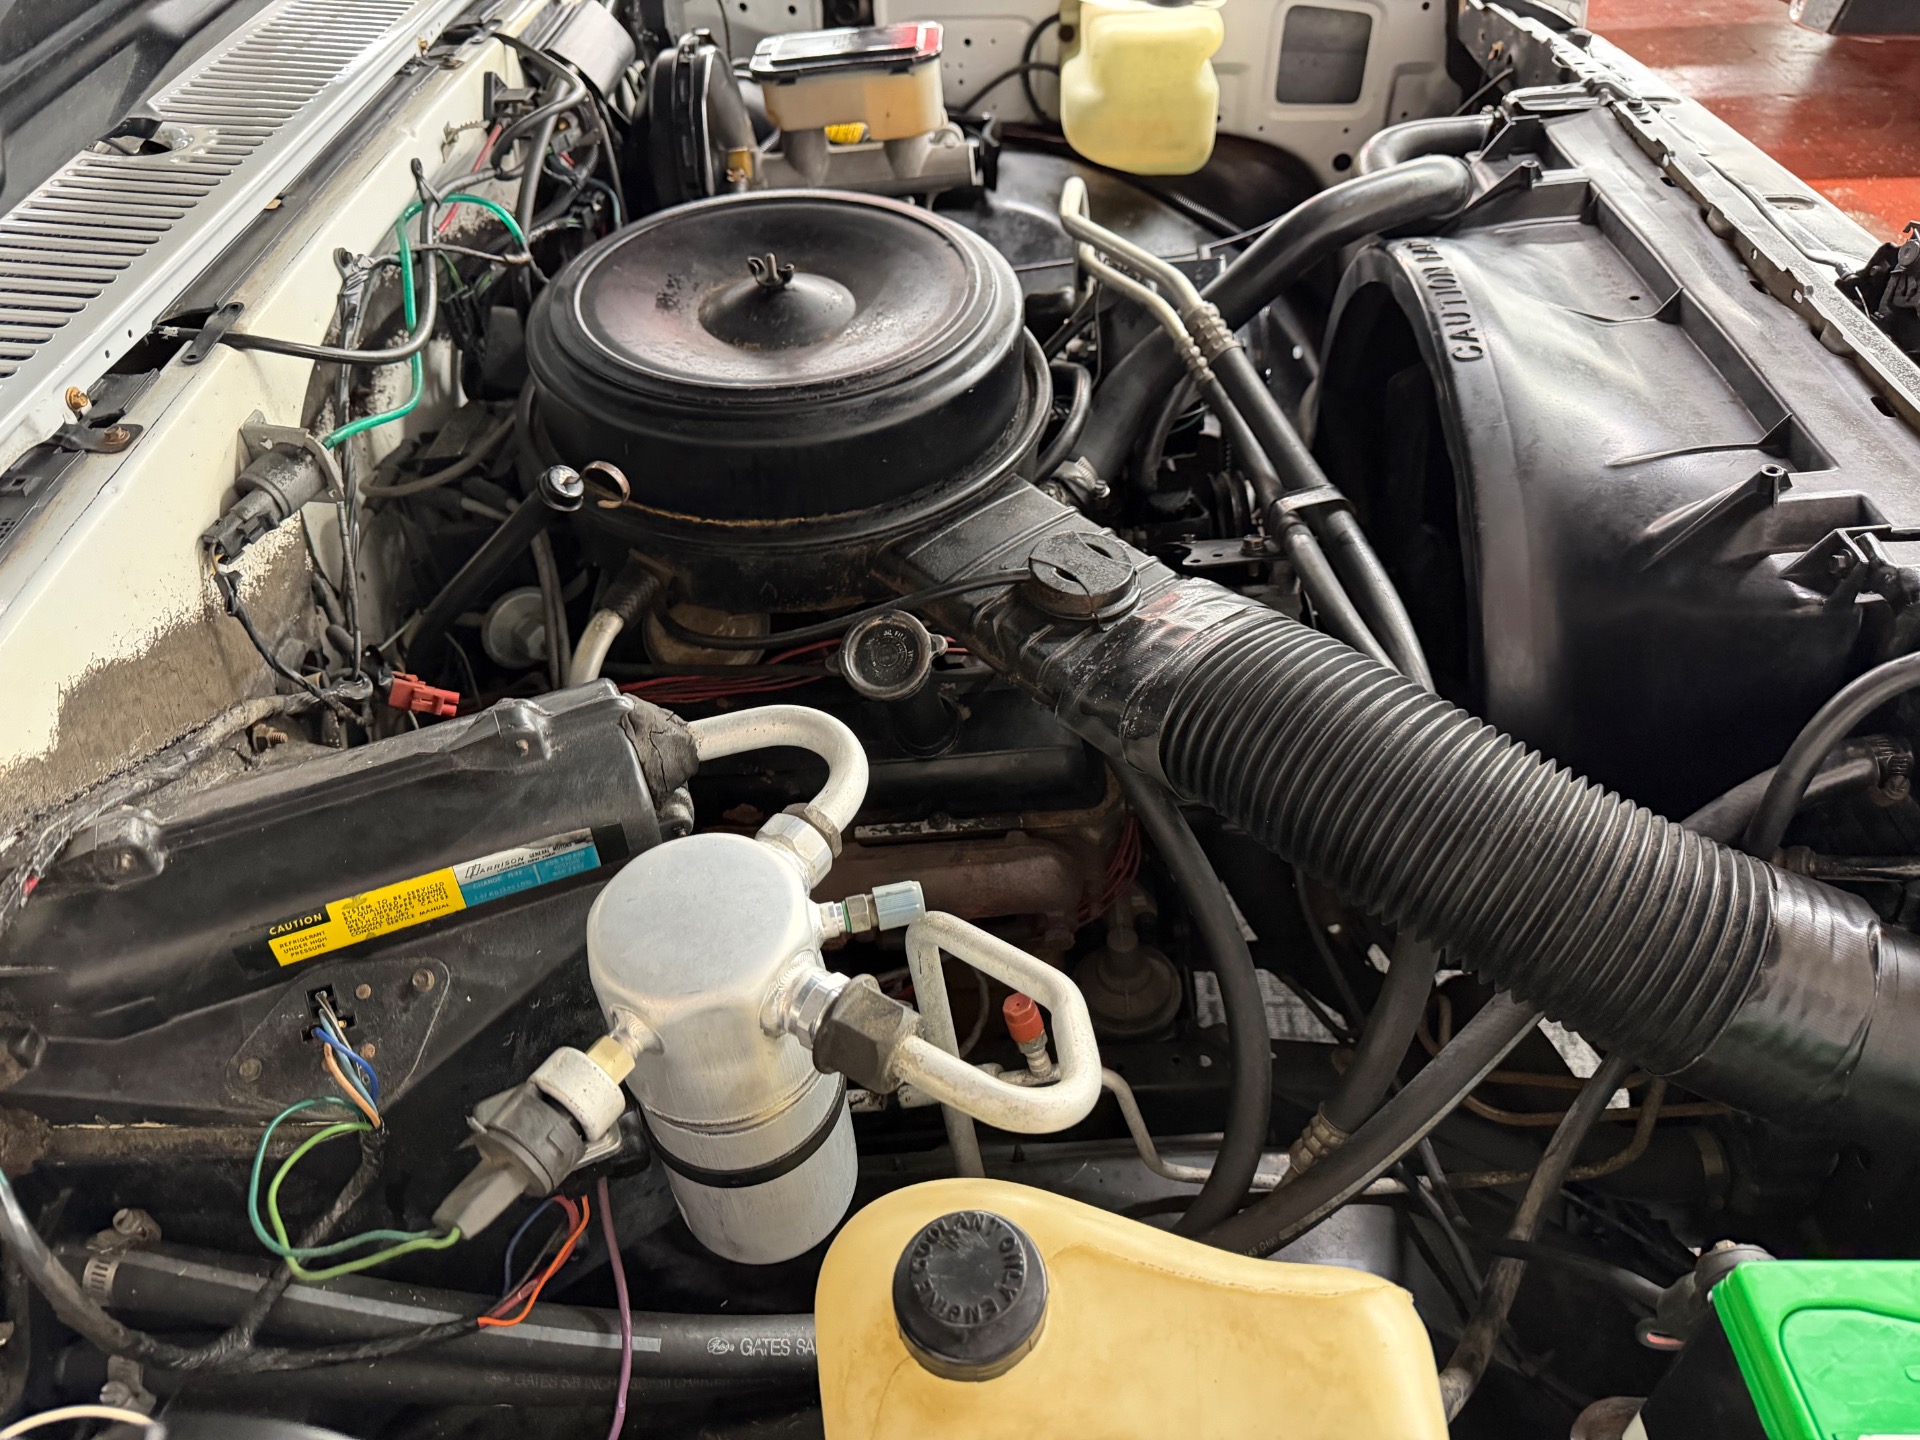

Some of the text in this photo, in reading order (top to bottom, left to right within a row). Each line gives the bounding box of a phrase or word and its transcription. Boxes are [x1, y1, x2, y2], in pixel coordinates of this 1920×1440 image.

[1421, 266, 1484, 362] CAUTION
[529, 849, 550, 858] GENERAL
[342, 904, 372, 917] SYSTEM
[407, 881, 445, 897] SERVICED
[357, 900, 399, 917] QUALIFIED
[403, 886, 445, 903] PERSONNEL
[374, 901, 413, 917] IMPROPER
[417, 890, 447, 903] SERVICE
[269, 912, 322, 936] CAUTION
[347, 894, 449, 930] METHODS MAY CAUSE
[351, 903, 449, 937] CONSULT SERVICE MANUAL
[349, 920, 383, 933] PERSONAL
[279, 931, 325, 949] REFRIGERANT
[284, 936, 327, 954] UNDER HIGH
[291, 943, 326, 957] PRESSURE
[911, 1211, 1024, 1325] ENGINE COOLANT ONLY
[740, 1337, 791, 1356] GATES
[514, 1373, 558, 1389] GATES
